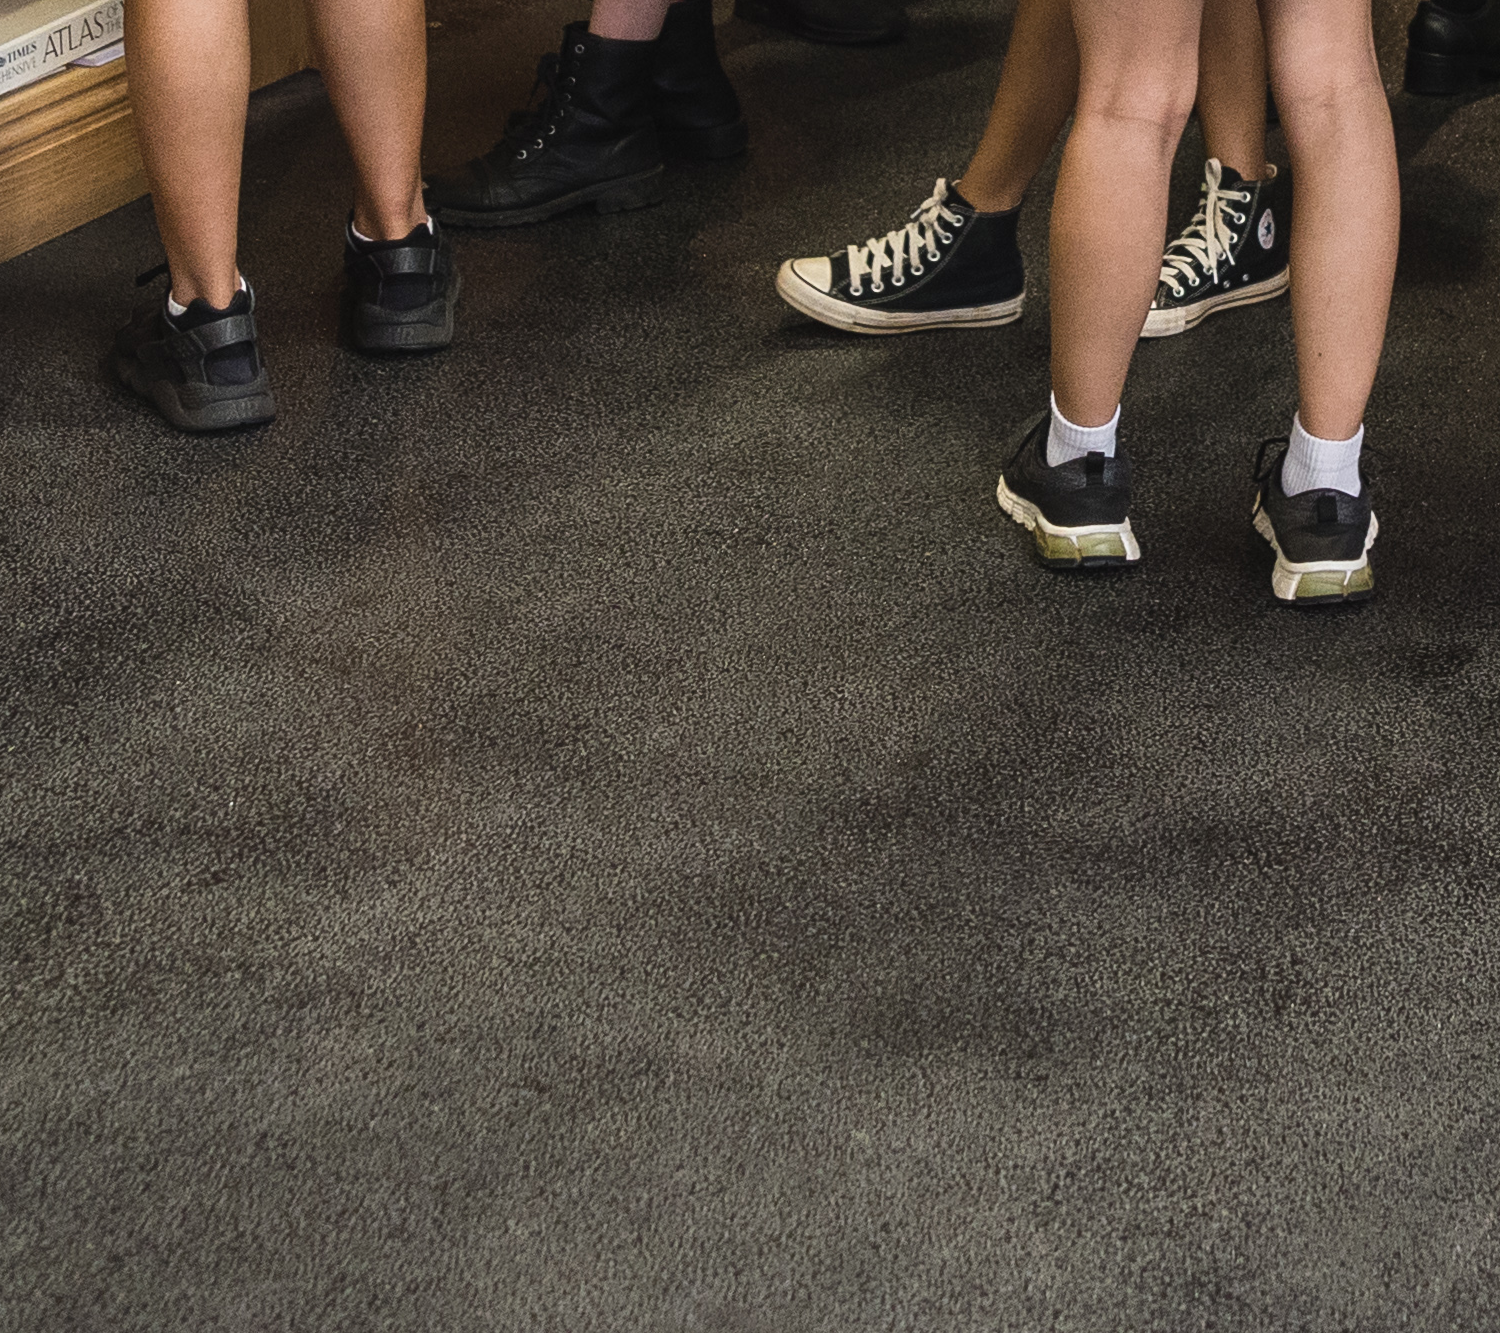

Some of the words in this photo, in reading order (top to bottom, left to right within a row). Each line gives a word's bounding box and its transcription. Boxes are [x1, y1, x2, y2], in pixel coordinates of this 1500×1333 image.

[106, 5, 119, 21] OF
[42, 10, 105, 64] ATLAS
[7, 40, 38, 65] TIMES
